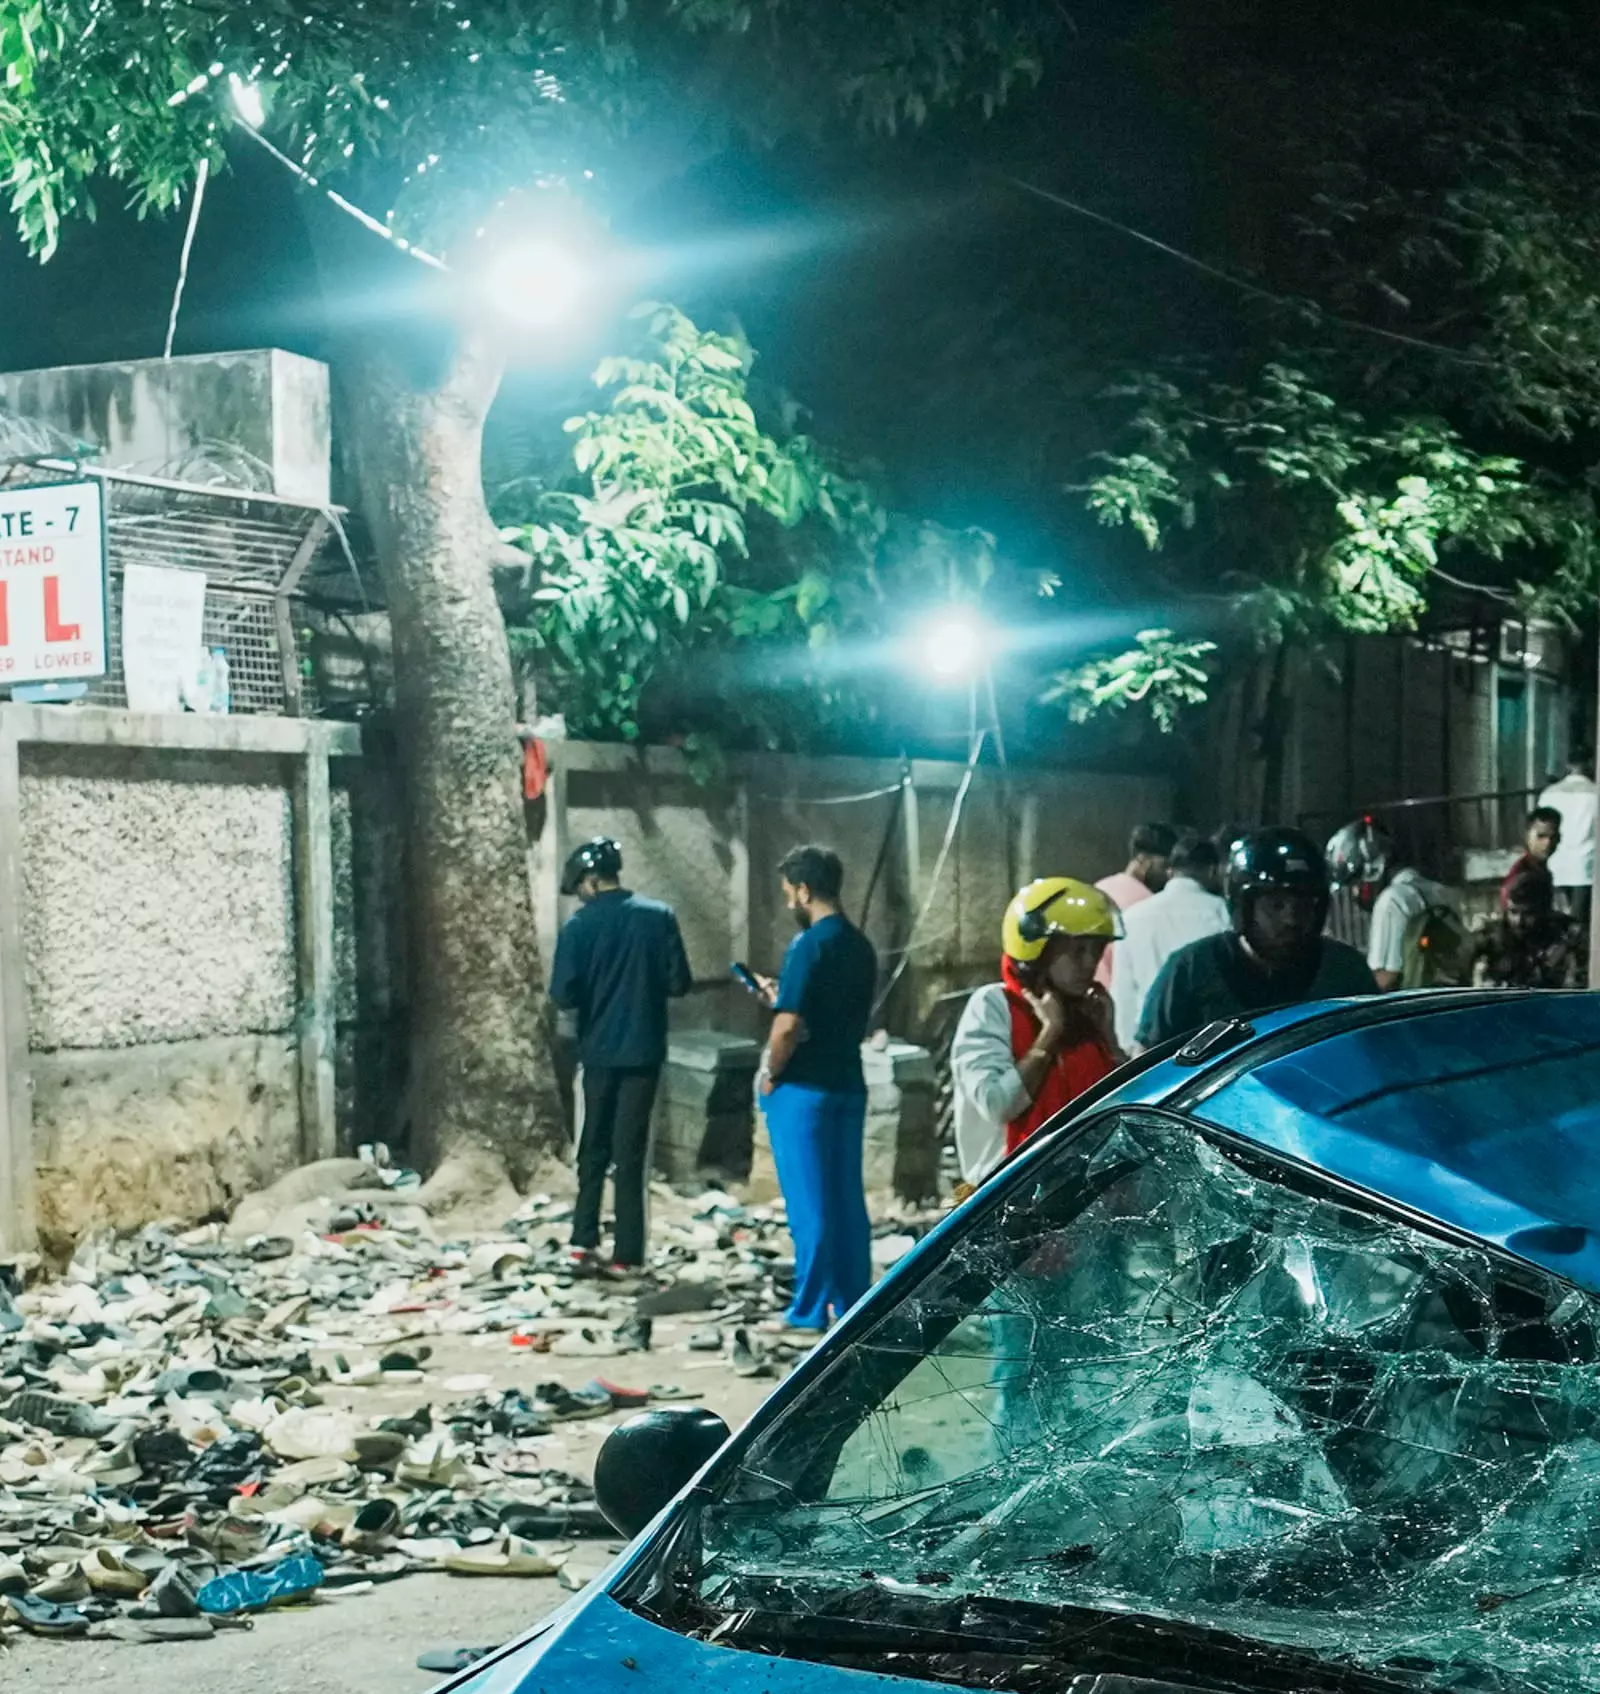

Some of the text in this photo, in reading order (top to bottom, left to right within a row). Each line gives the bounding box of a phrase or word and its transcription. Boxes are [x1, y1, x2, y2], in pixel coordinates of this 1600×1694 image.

[65, 506, 80, 532] 7
[43, 575, 80, 642] L
[34, 651, 93, 671] LOWER
